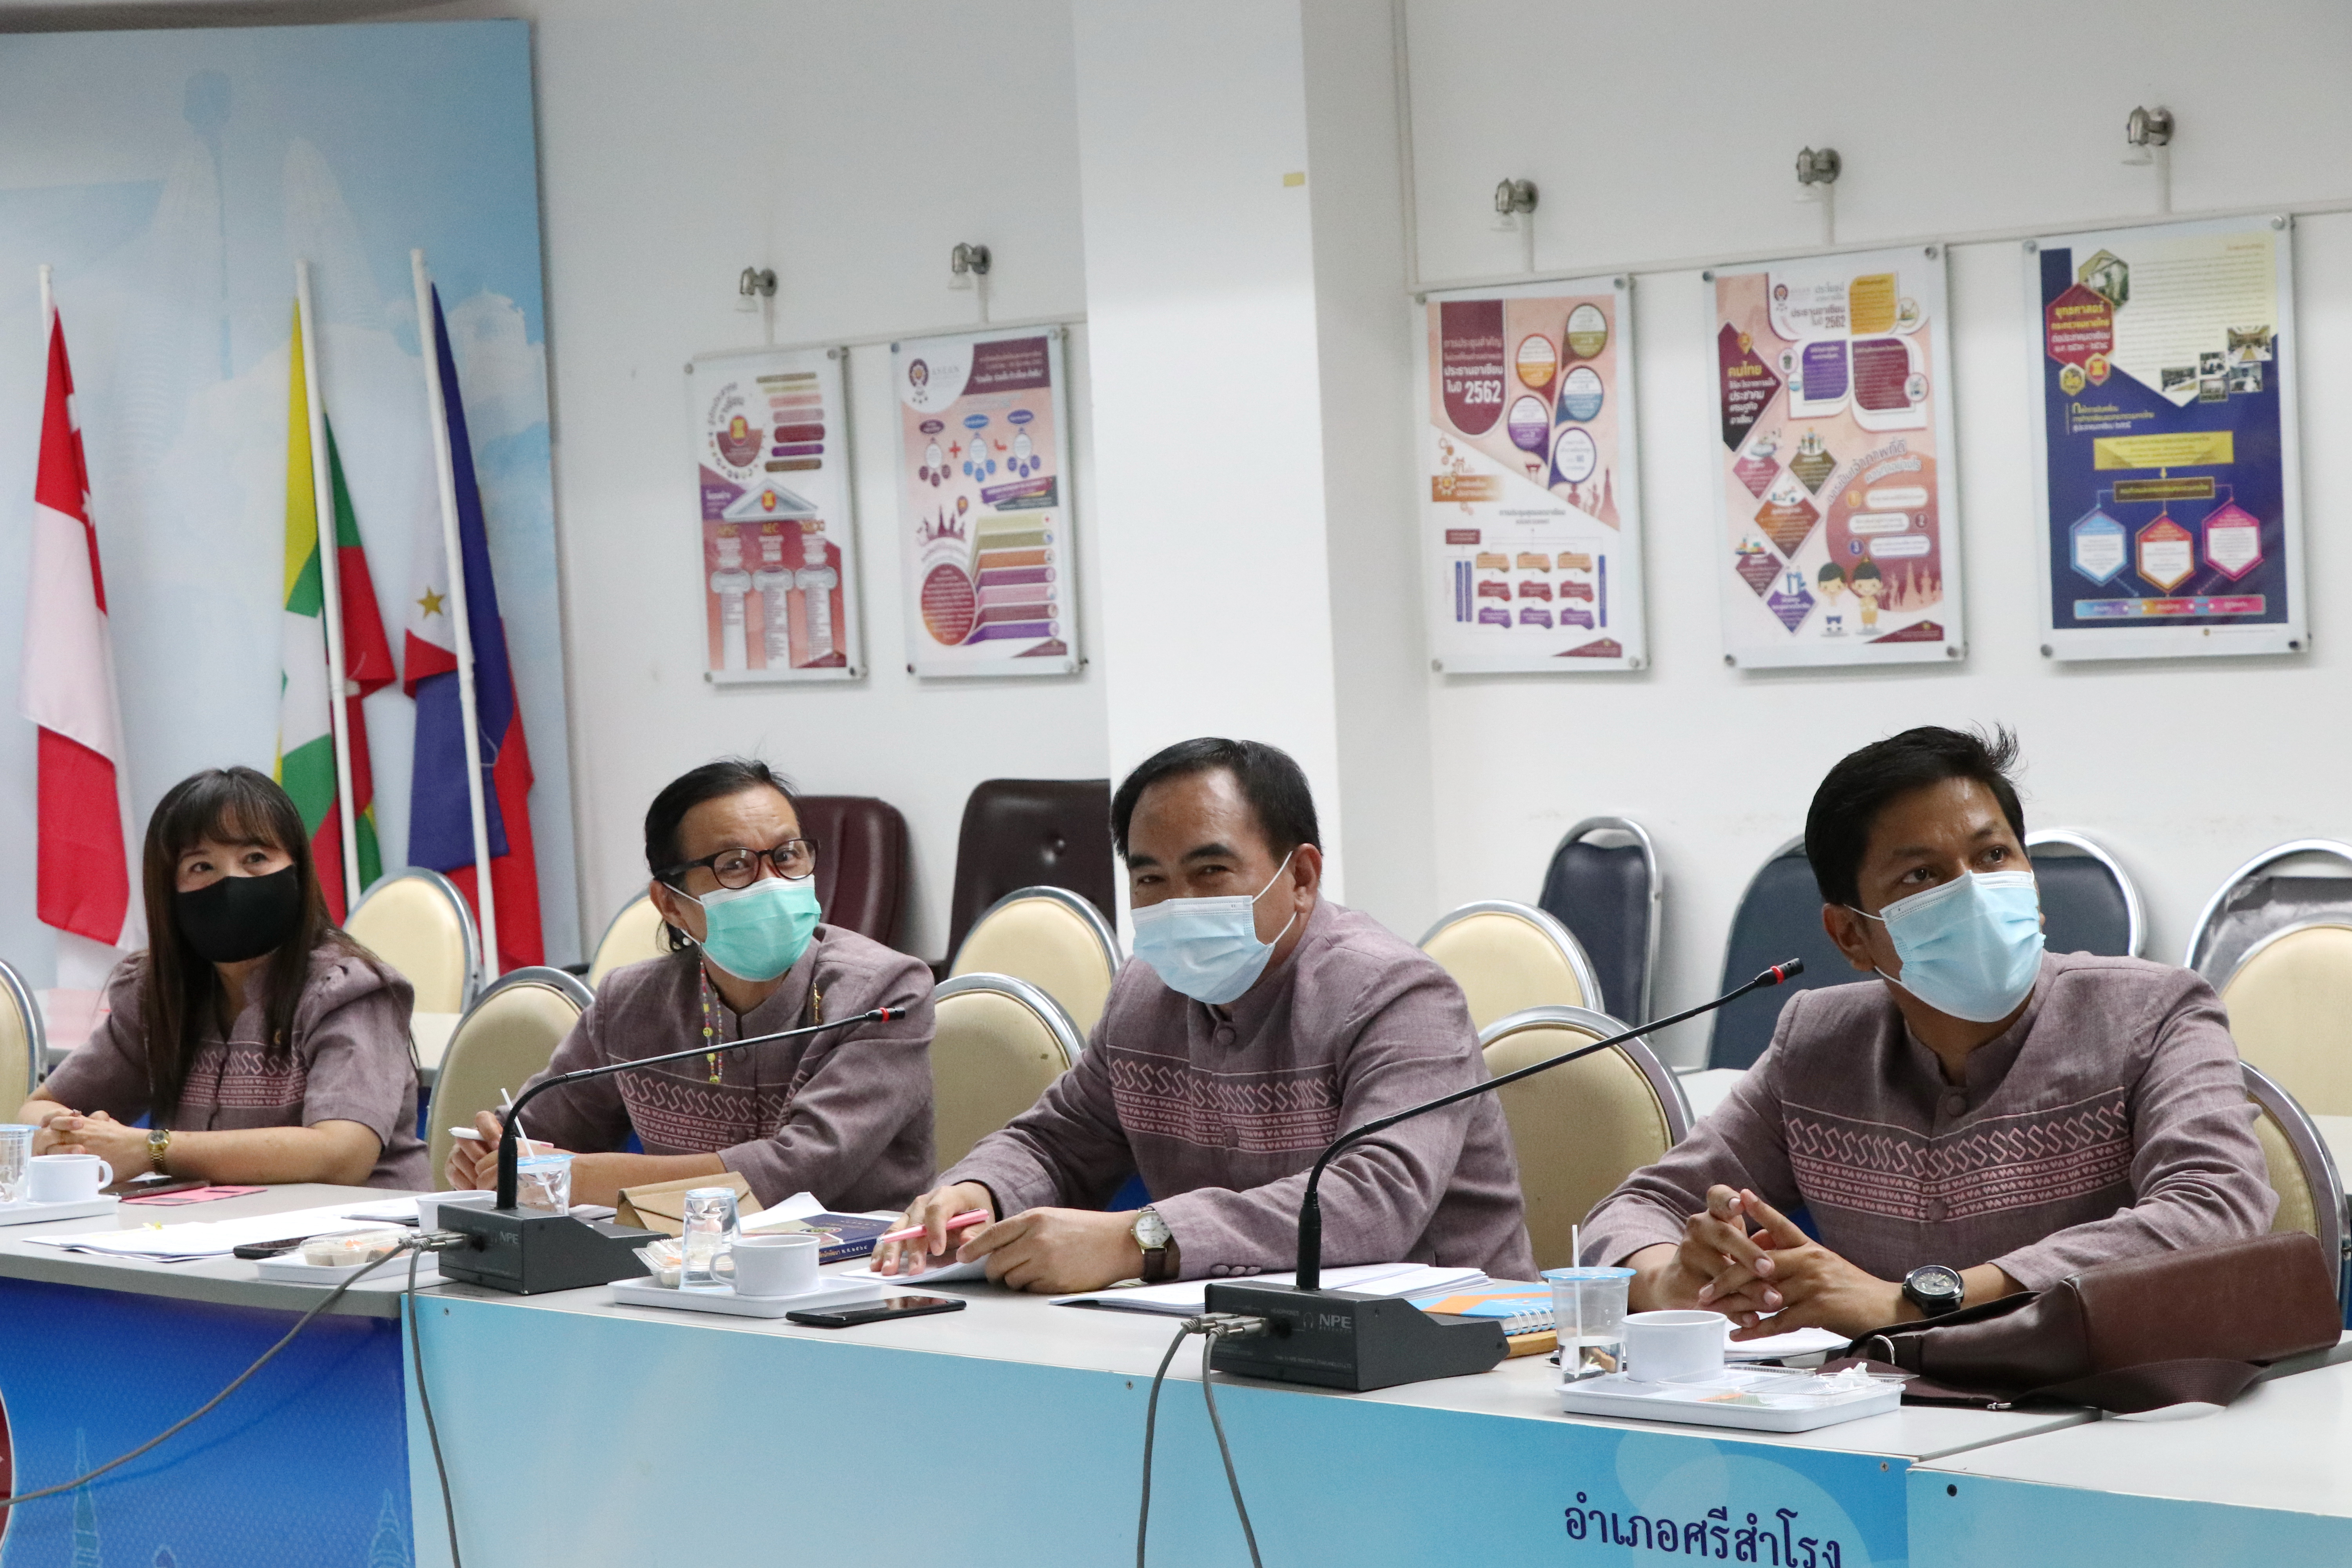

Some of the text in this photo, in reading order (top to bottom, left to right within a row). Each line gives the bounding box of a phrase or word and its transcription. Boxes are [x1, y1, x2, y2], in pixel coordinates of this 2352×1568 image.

[1825, 315, 1846, 328] 2562
[1444, 363, 1503, 377] ประธานอาเซียน
[1728, 360, 1762, 377] คนไทย
[1465, 379, 1502, 404] 2562
[1729, 390, 1765, 401] ประชาคม
[500, 1231, 519, 1244] NPE
[1271, 1308, 1299, 1316] HEADPHONES
[1319, 1314, 1352, 1329] NPE
[1564, 1492, 1841, 1568] อำเภอศรีสำโรง
